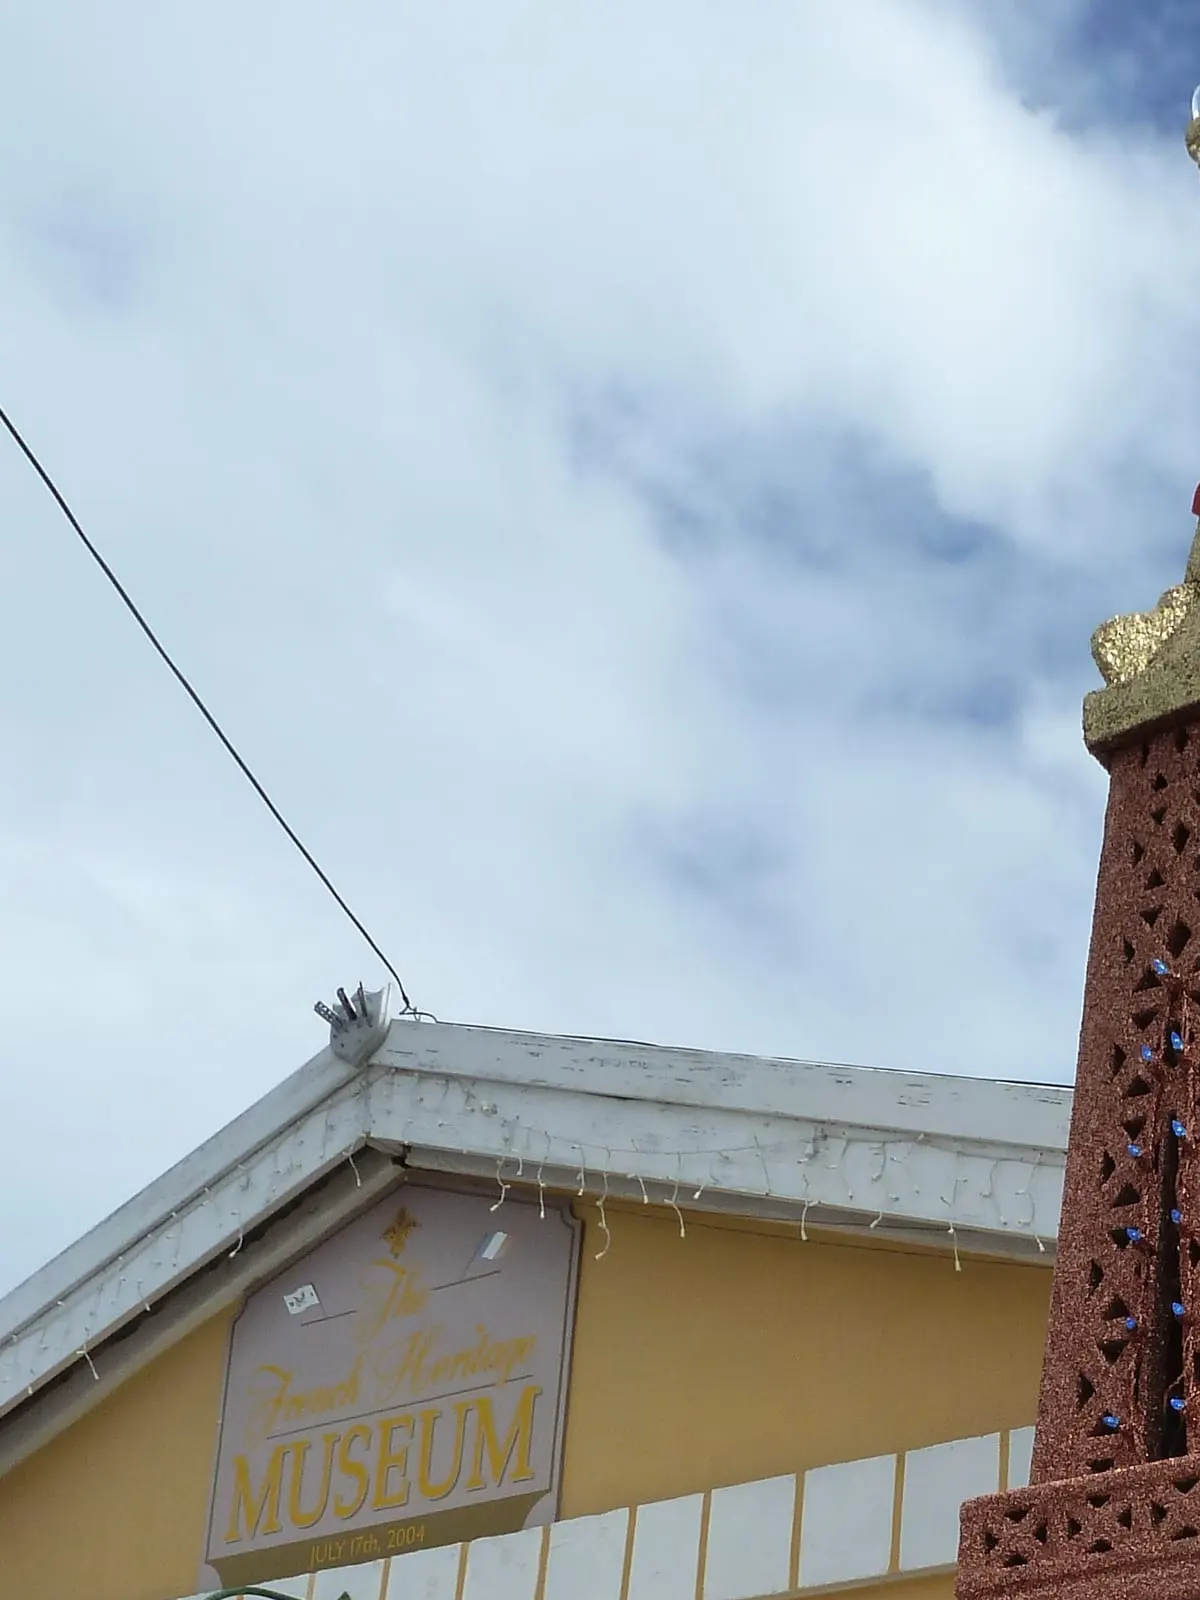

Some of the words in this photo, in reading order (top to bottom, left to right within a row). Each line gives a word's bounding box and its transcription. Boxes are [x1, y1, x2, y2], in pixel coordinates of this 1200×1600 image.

[356, 1258, 431, 1343] The
[244, 1350, 364, 1448] French
[374, 1322, 538, 1402] Heritage
[224, 1386, 542, 1544] MUSEUM
[309, 1540, 346, 1569] JULY
[350, 1534, 382, 1557] 17th,
[386, 1524, 425, 1549] 2004
